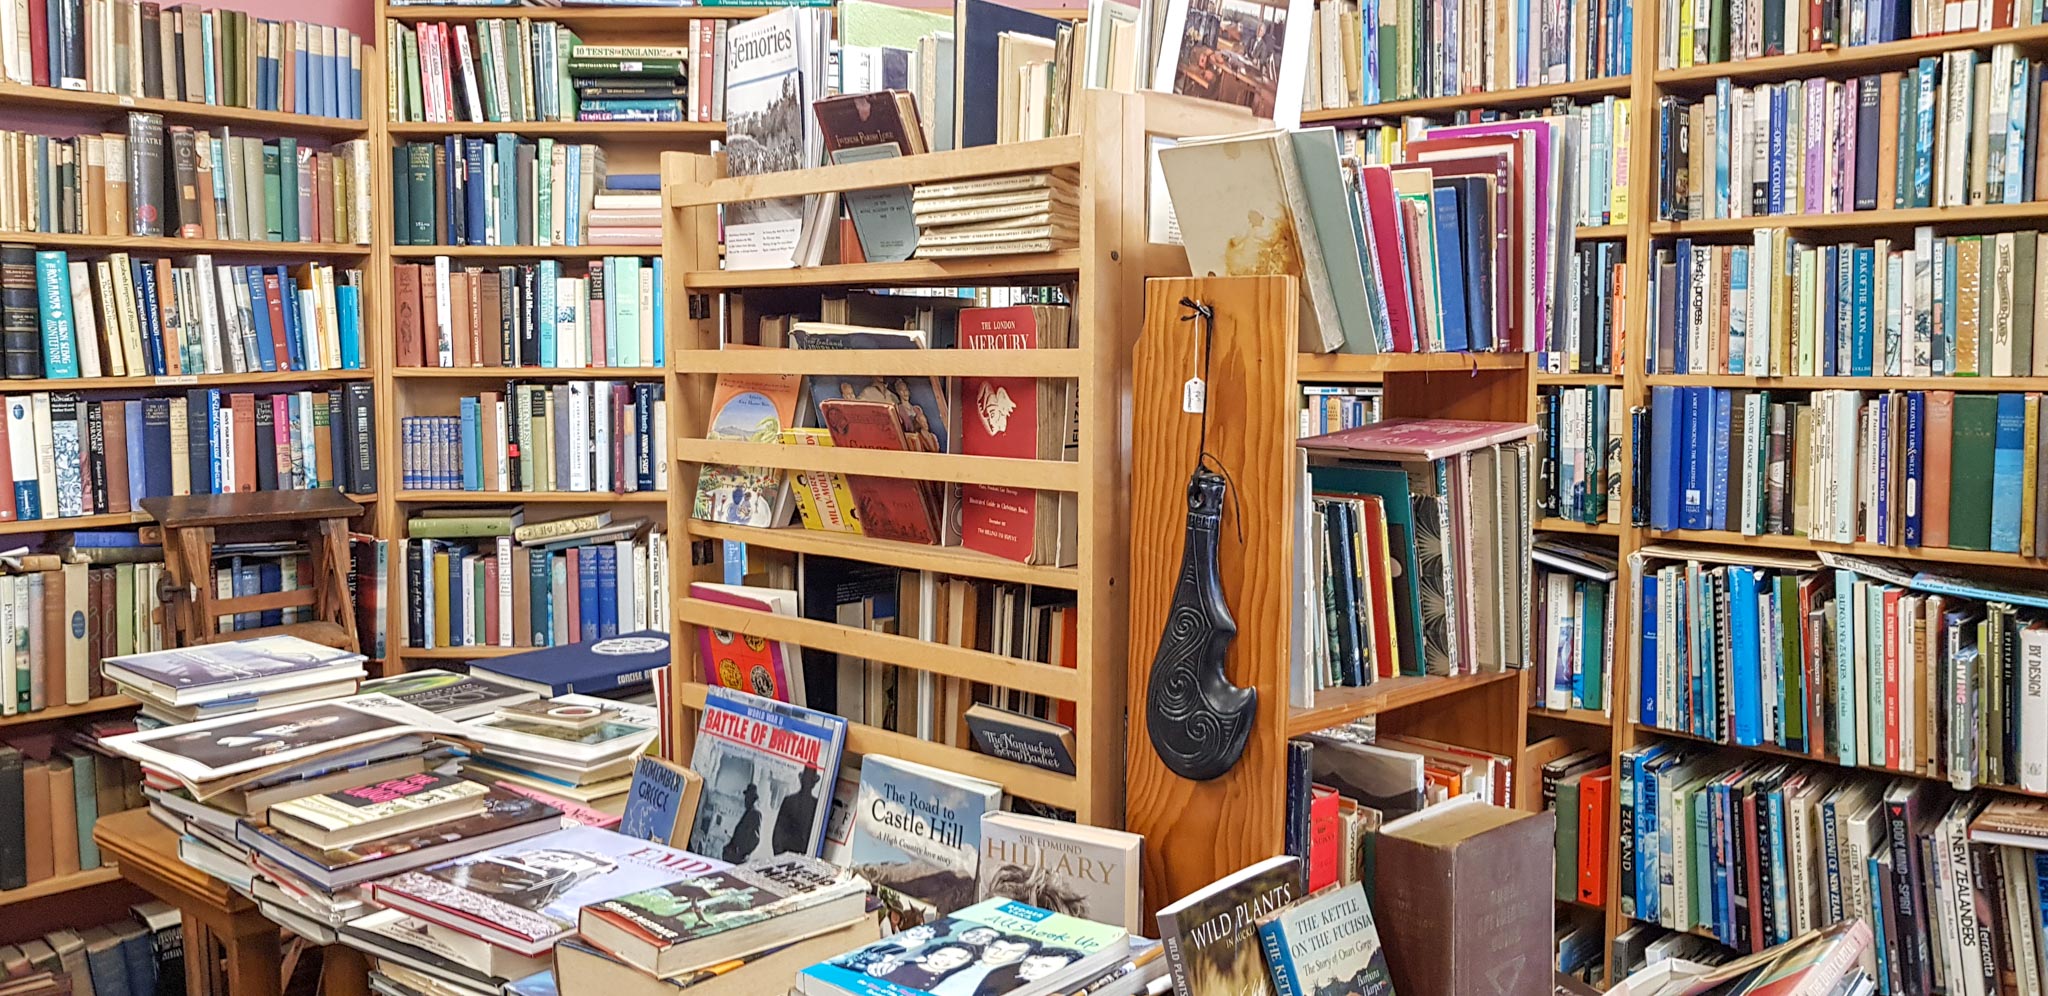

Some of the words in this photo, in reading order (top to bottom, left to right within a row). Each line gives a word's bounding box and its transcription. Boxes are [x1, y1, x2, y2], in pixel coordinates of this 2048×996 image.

[727, 28, 792, 72] Memories
[1693, 250, 1705, 283] poverty
[1999, 252, 2010, 266] THE
[1693, 286, 1705, 326] progress
[993, 320, 1016, 330] LONDON
[46, 320, 61, 365] MONTEFIORE
[61, 342, 71, 364] SEBAG
[969, 333, 1029, 350] MERCURY
[358, 417, 368, 433] BONES
[360, 441, 370, 471] SCATTERED
[809, 475, 821, 501] MORE
[1873, 643, 1884, 676] Industrial
[2028, 644, 2039, 658] BY
[617, 671, 643, 685] CONCISE
[2028, 660, 2041, 697] DESIGN
[747, 707, 765, 721] WORLD
[766, 711, 779, 723] WAR
[705, 708, 749, 740] BATTLE
[751, 722, 768, 745] OF
[768, 728, 821, 763] BRITAIN
[999, 733, 1056, 758] Nantucket
[1021, 751, 1060, 768] Basket
[639, 758, 681, 793] REMEMBER
[638, 781, 670, 812] GREECE
[884, 782, 906, 806] The
[908, 792, 941, 816] Road
[943, 801, 955, 820] to
[871, 799, 925, 836] Castle
[930, 816, 963, 851] Hill
[1825, 809, 1833, 817] A
[1019, 833, 1036, 844] SIR
[1036, 837, 1082, 855] EDMUND
[1622, 810, 1632, 871] ZEALAND
[1825, 817, 1837, 857] PORTRAIT
[1892, 820, 1906, 847] BODY,
[883, 832, 899, 846] High
[899, 839, 922, 856] Country
[923, 850, 936, 861] love
[936, 854, 953, 867] story
[986, 836, 1117, 885] HILLARY
[1827, 858, 1838, 870] OF
[1895, 848, 1908, 874] MIND
[1951, 836, 1966, 865] NEW
[1829, 872, 1840, 892] NEW
[1898, 883, 1912, 916] SPIRIT
[1955, 870, 1976, 946] ZEALANDERS
[1191, 912, 1233, 951] WILD
[1234, 882, 1292, 931] PLANTS
[1295, 915, 1320, 936] THE
[1321, 897, 1361, 926] KETTLE
[1074, 935, 1099, 949] Up
[1167, 936, 1180, 961] WILD
[1226, 936, 1233, 948] IN
[1265, 931, 1282, 962] THE
[1291, 941, 1307, 960] ON
[1309, 930, 1333, 951] THE
[1333, 913, 1373, 943] FUCHSIA
[1979, 926, 1995, 977] Terracotta
[1303, 963, 1316, 977] The
[1315, 957, 1332, 971] Story
[1356, 939, 1373, 955] Gorge
[1357, 968, 1380, 988] Barbara
